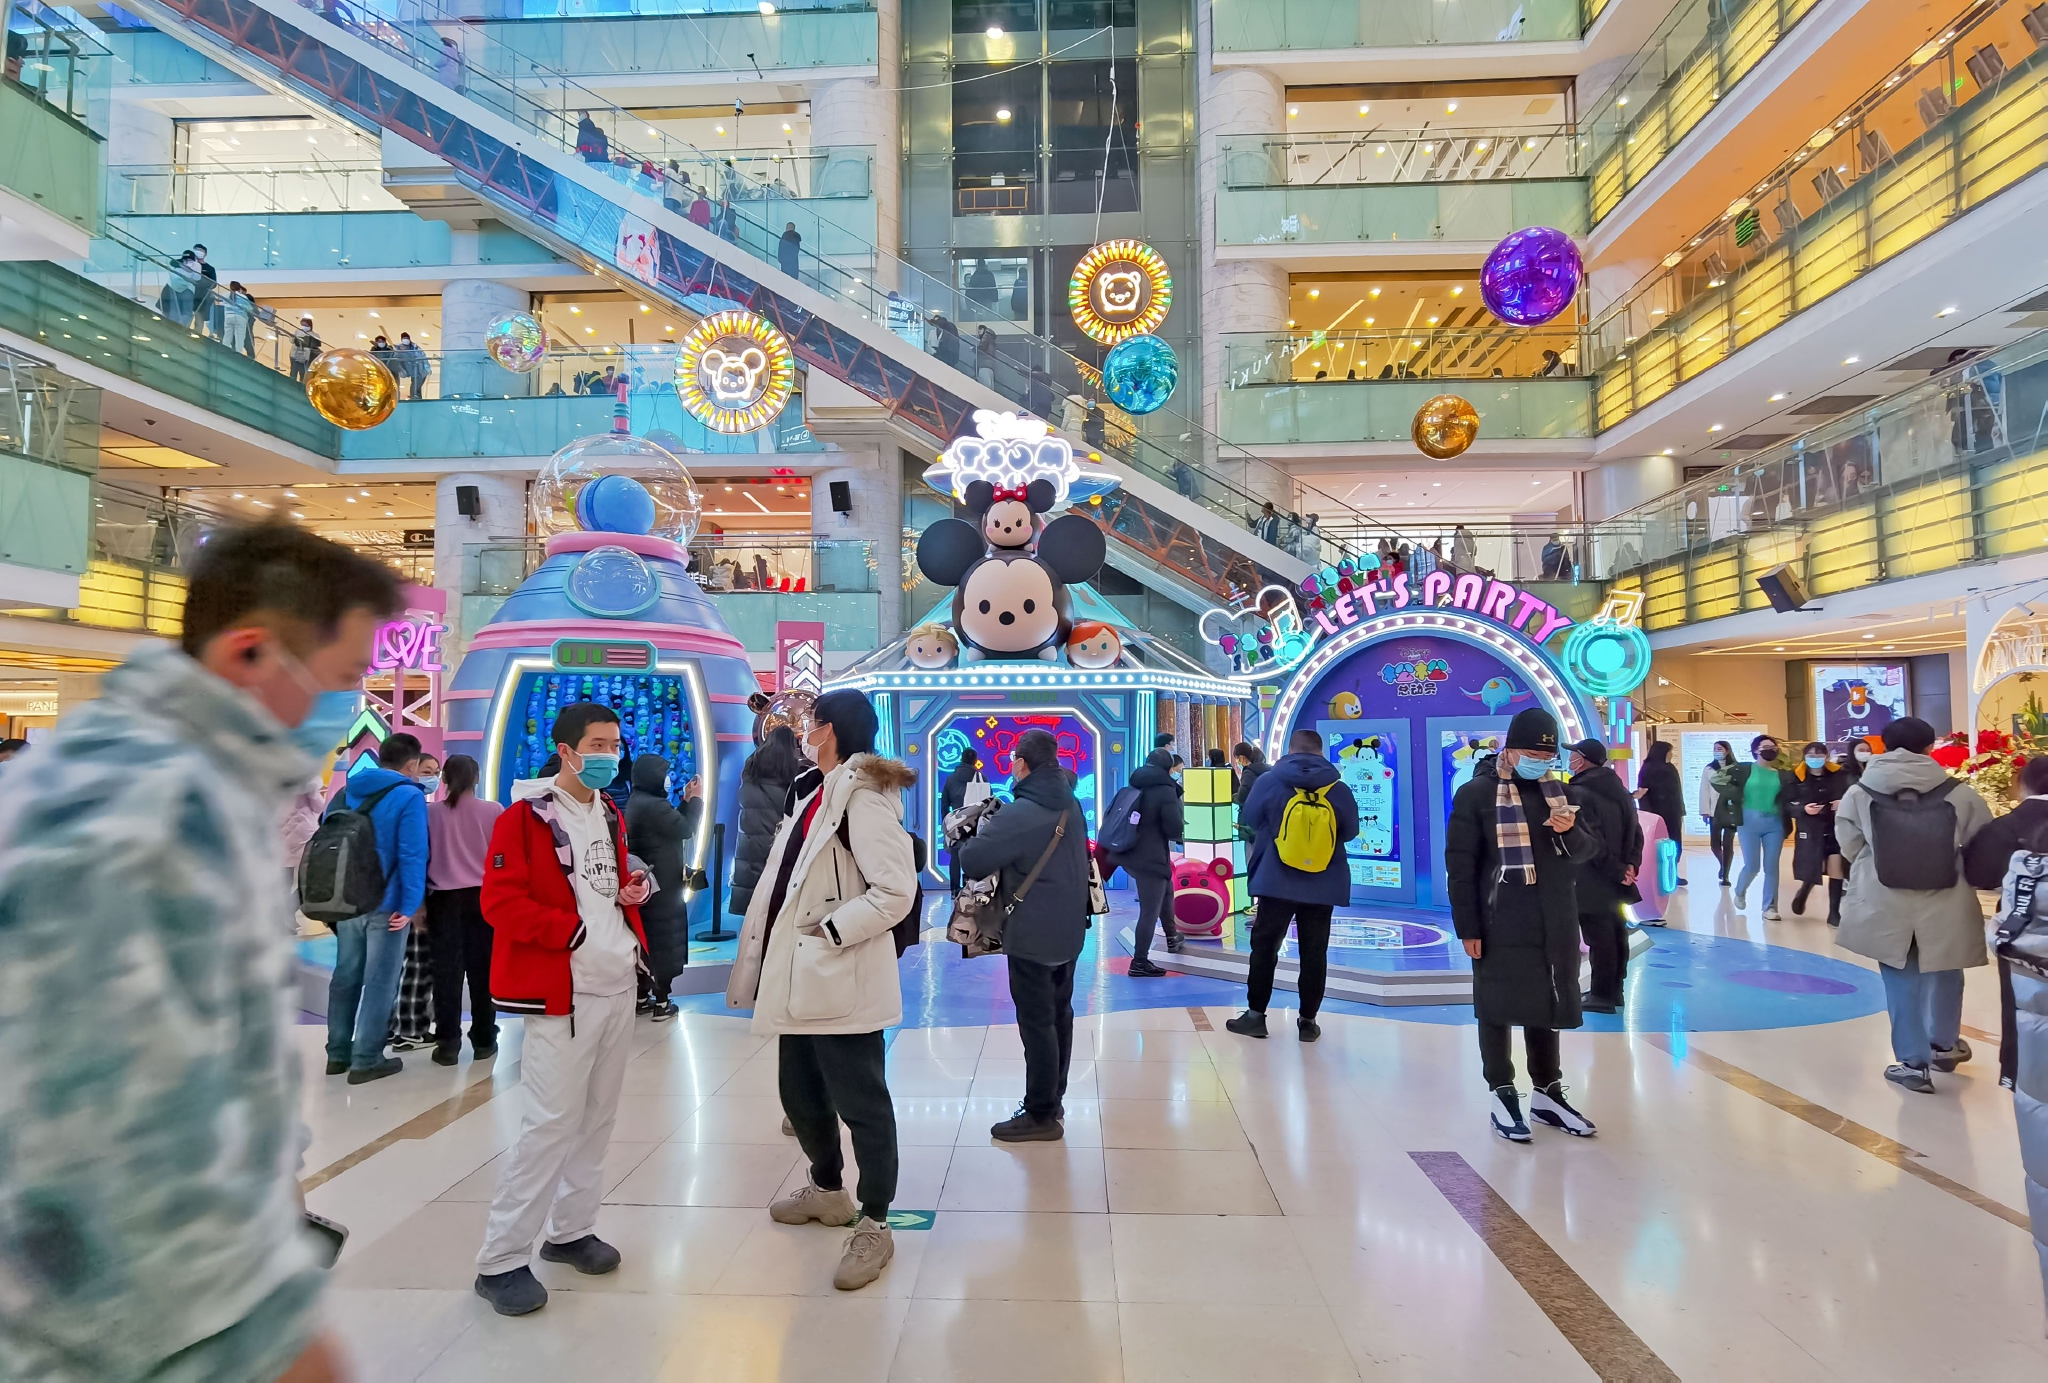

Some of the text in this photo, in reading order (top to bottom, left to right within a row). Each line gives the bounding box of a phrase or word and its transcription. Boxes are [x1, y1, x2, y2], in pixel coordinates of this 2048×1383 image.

[1314, 571, 1574, 644] LET'S PARTY
[372, 621, 444, 672] LOVE
[1397, 682, 1438, 697] 总动员
